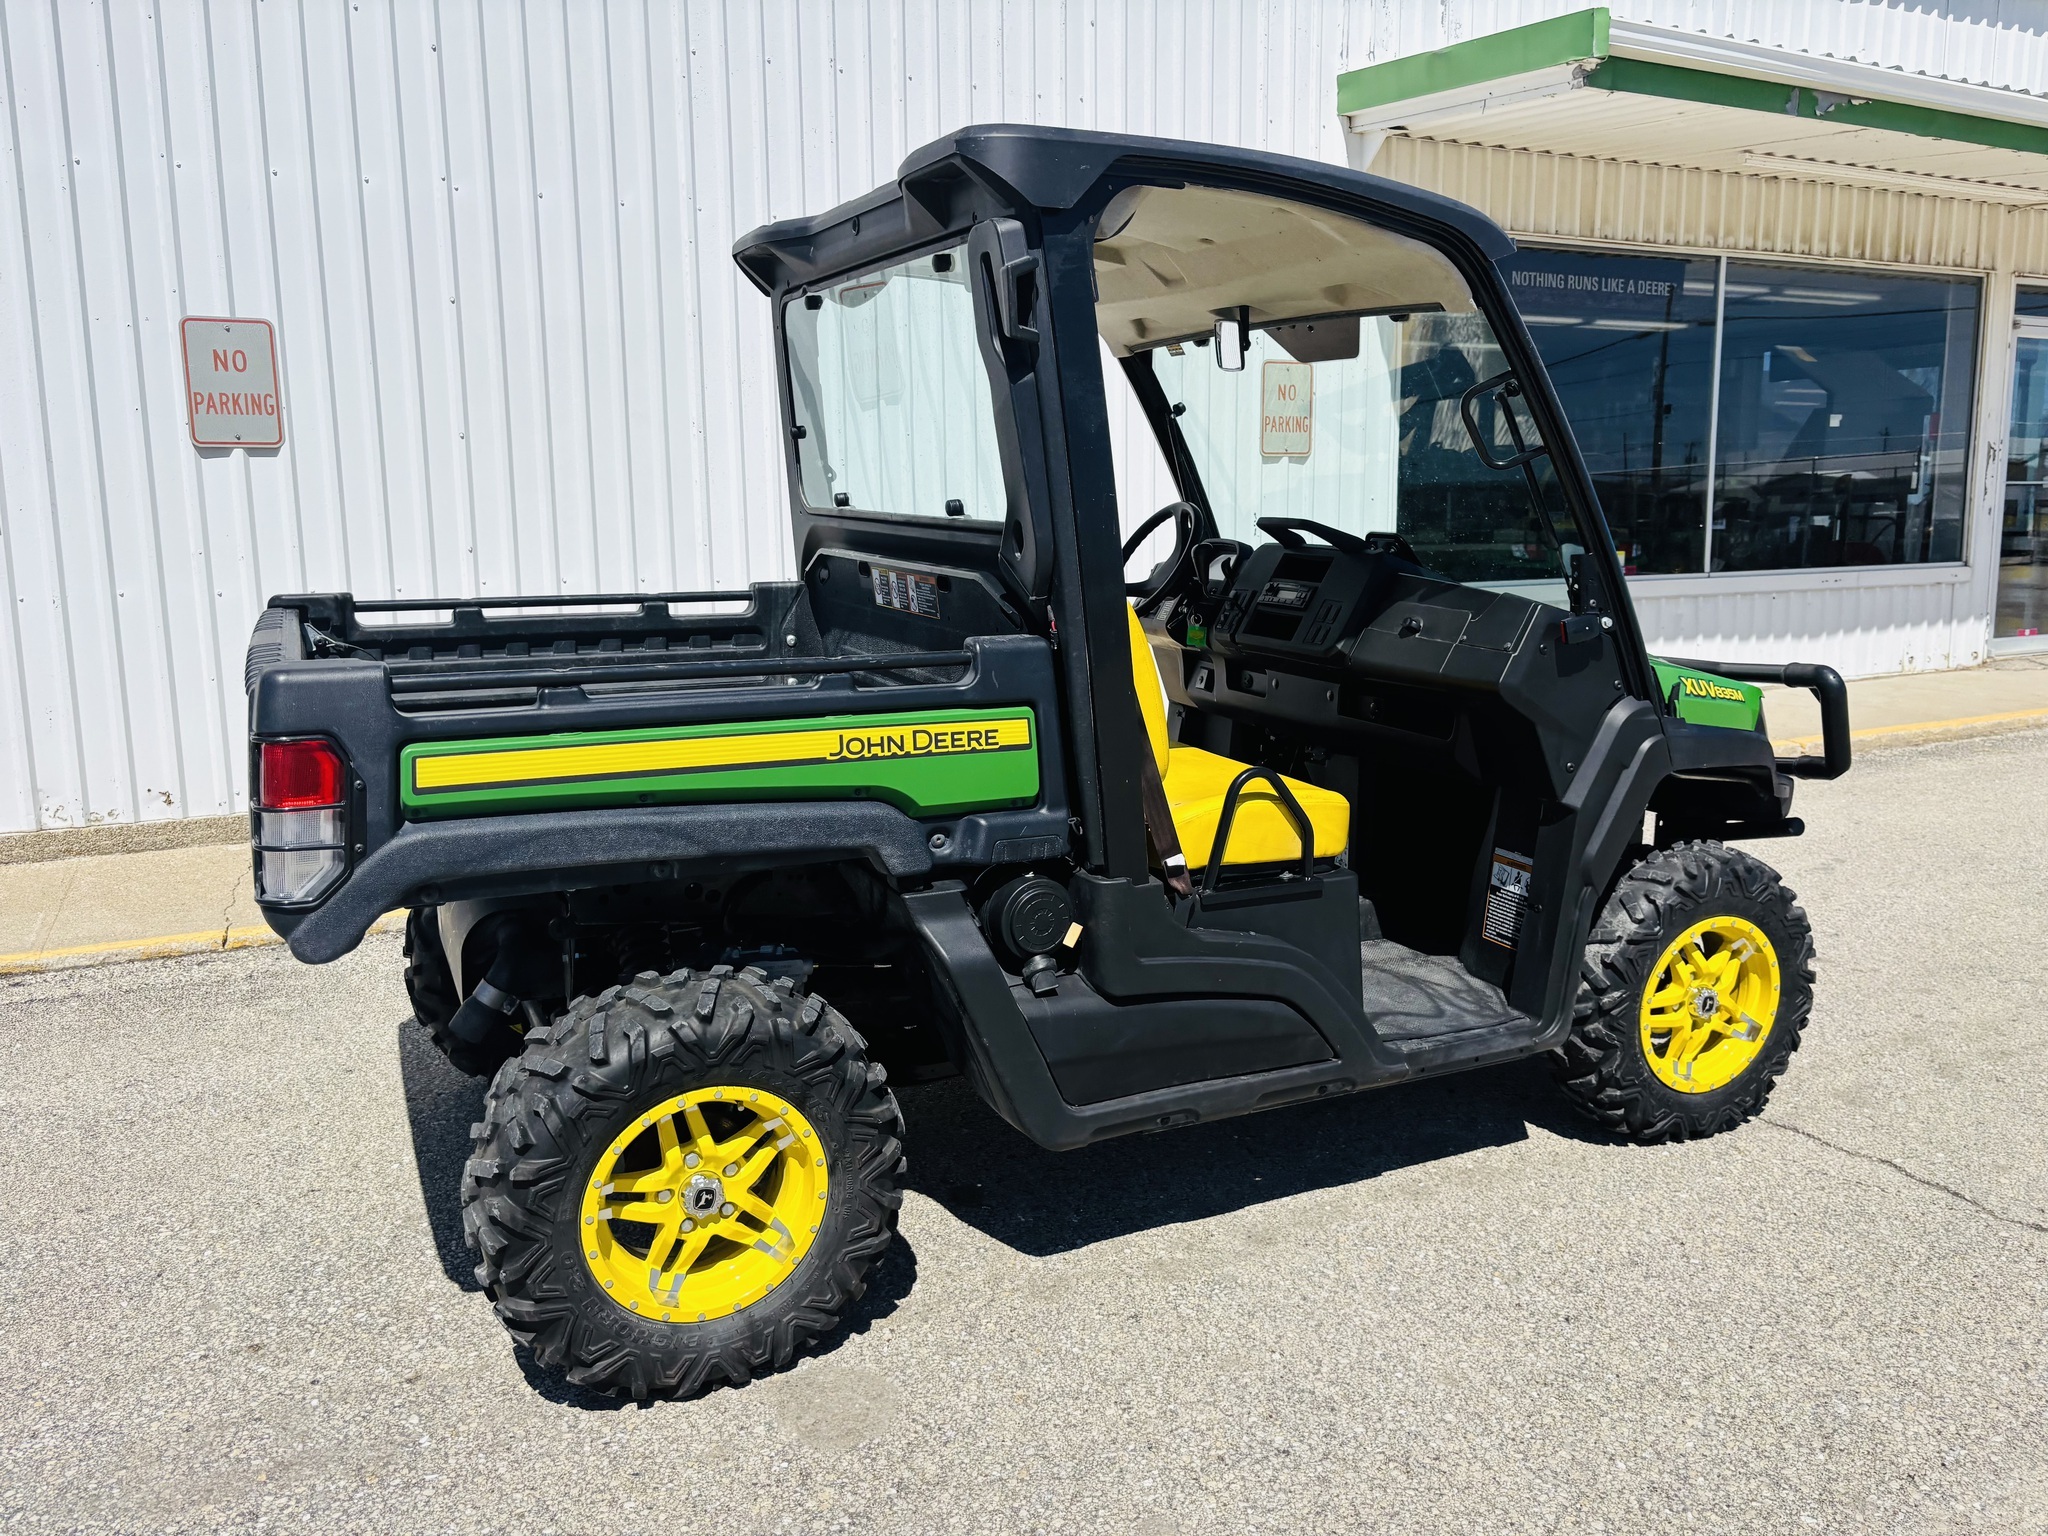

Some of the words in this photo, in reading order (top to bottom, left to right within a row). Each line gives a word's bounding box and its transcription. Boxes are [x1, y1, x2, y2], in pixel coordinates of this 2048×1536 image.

[1511, 271, 1565, 289] NOTHING
[1567, 275, 1599, 291] RUNS
[1601, 277, 1624, 293] LIKE
[1627, 279, 1635, 294] A
[1638, 280, 1671, 296] DEERE
[213, 349, 248, 373] NO
[193, 392, 275, 416] PARKING
[1277, 384, 1297, 401] NO
[1264, 415, 1309, 433] PARKING
[828, 733, 905, 757] JOHN
[911, 728, 999, 752] DEERE
